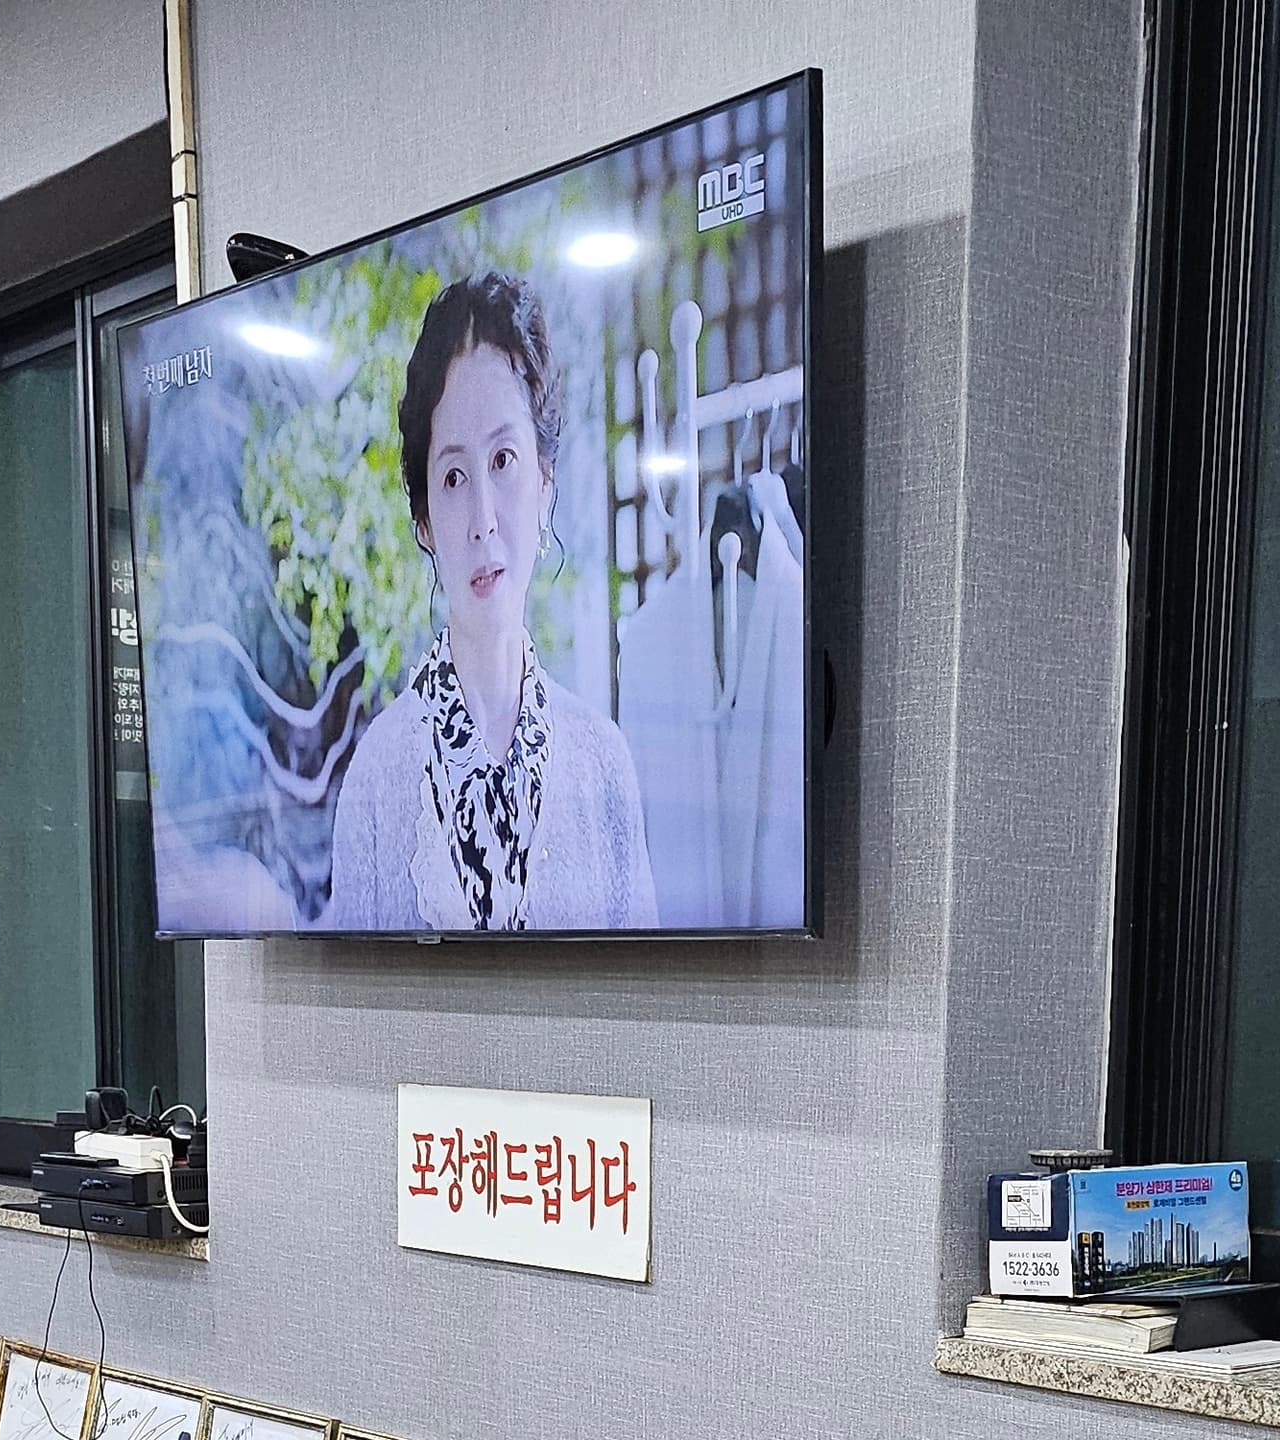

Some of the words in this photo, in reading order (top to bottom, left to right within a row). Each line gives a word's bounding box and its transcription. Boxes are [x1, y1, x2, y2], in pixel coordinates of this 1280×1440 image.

[697, 153, 765, 212] MBC
[721, 202, 744, 220] UHD
[185, 345, 212, 385] 남자
[407, 1126, 638, 1236] 포장해드립니다
[1002, 1260, 1060, 1277] 1522-3636
